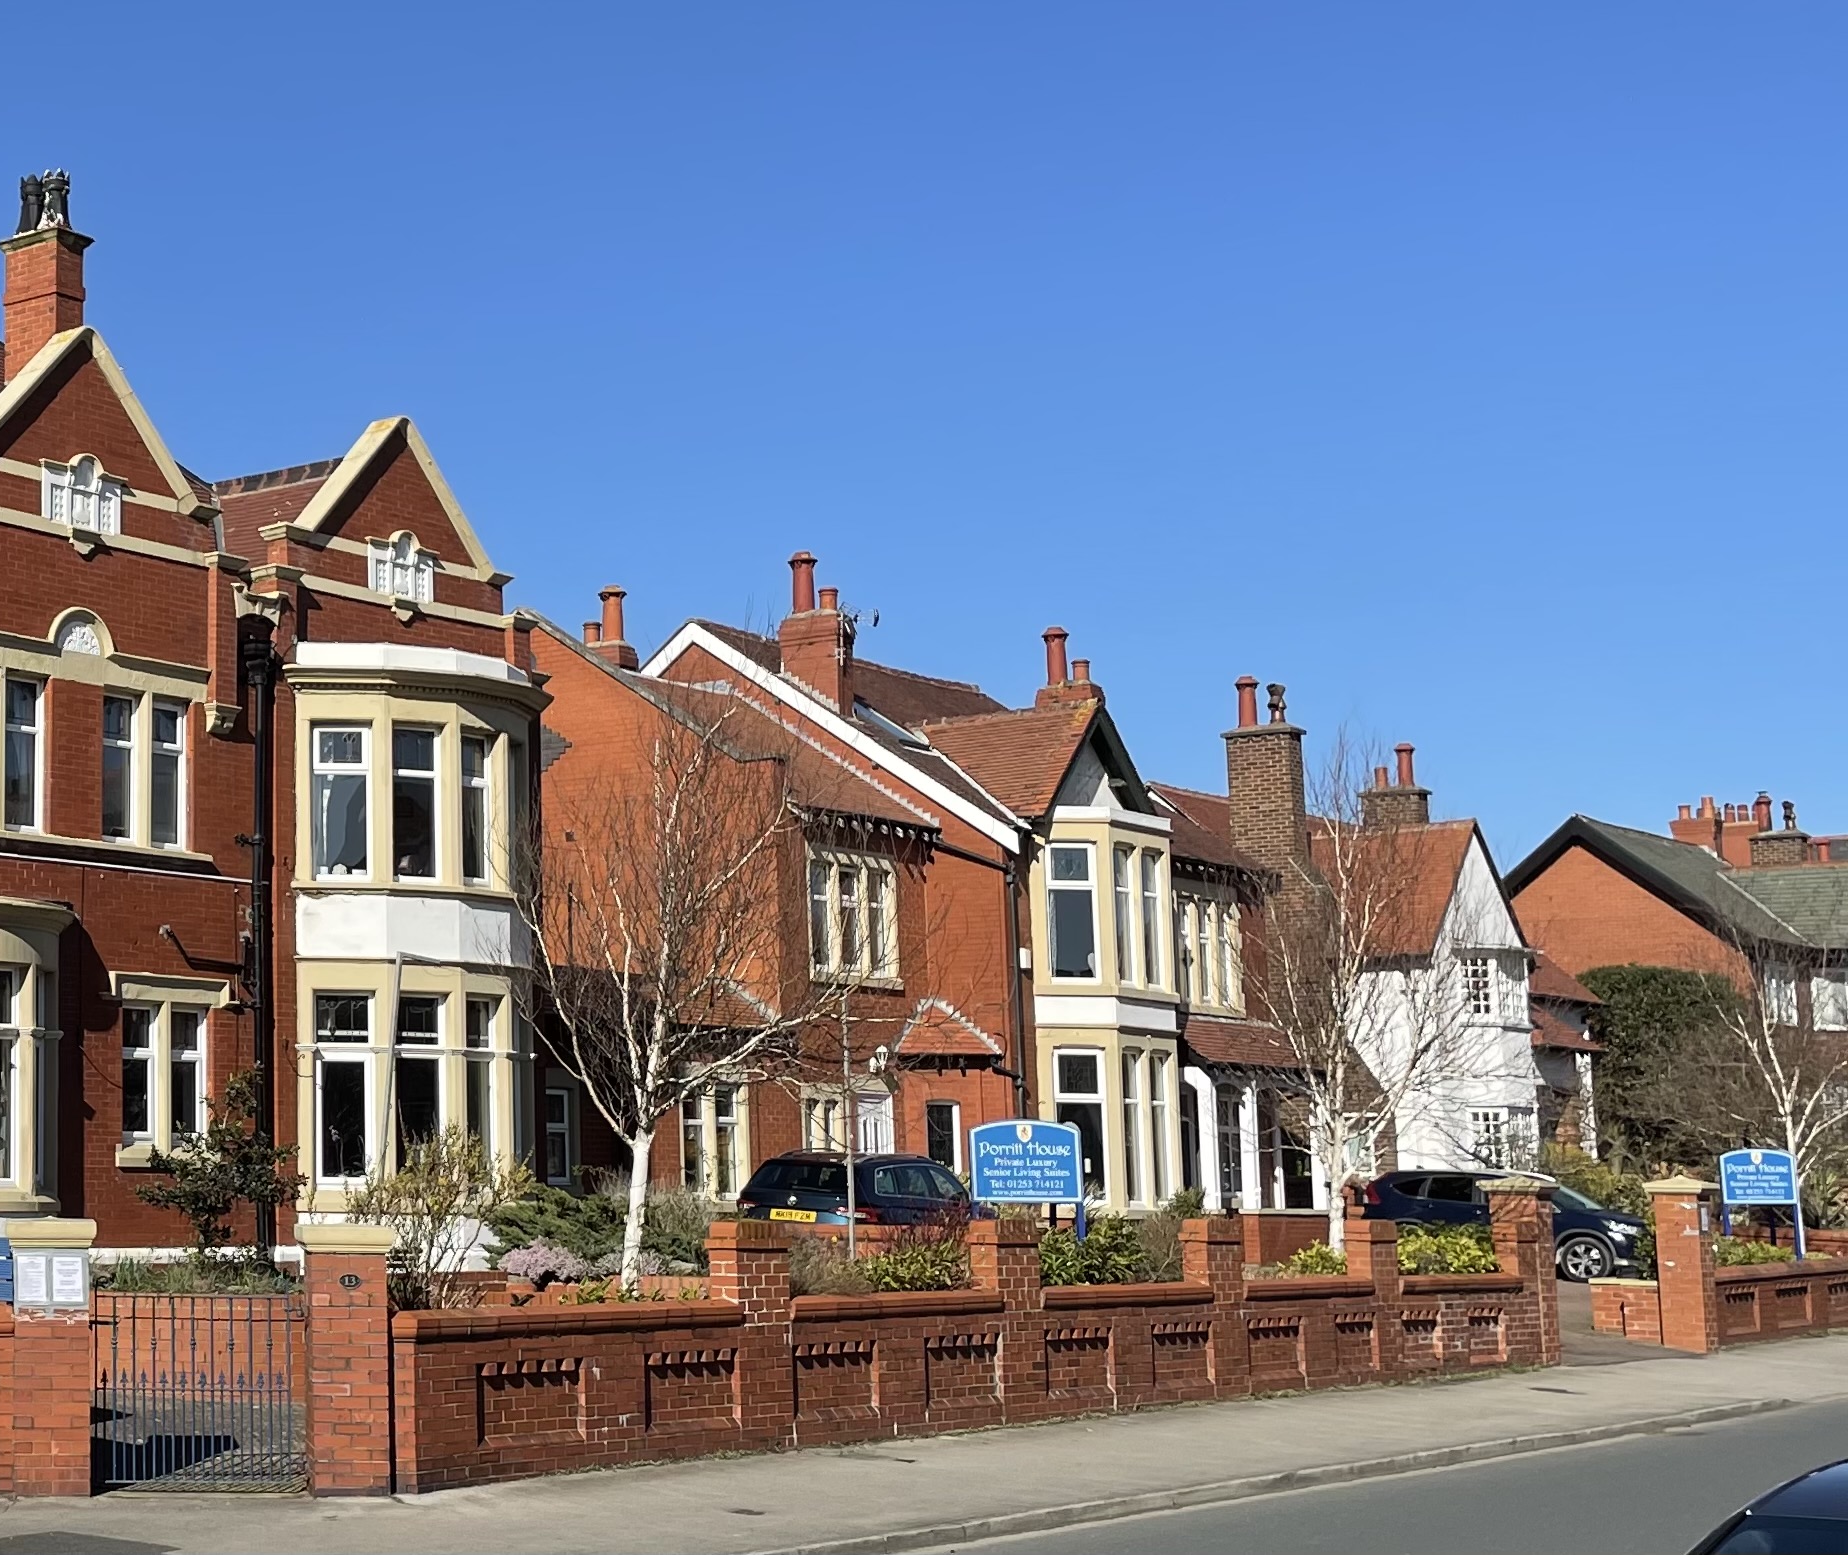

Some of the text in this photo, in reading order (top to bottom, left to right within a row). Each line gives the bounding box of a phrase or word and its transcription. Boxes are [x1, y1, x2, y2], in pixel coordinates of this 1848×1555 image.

[1026, 1141, 1072, 1157] House
[994, 1157, 1058, 1168] Private Luxury
[983, 1167, 1071, 1178] Senior Living Suites
[1006, 1180, 1033, 1188] 01253
[1034, 1180, 1064, 1188] 714121
[344, 1276, 357, 1286] 13
